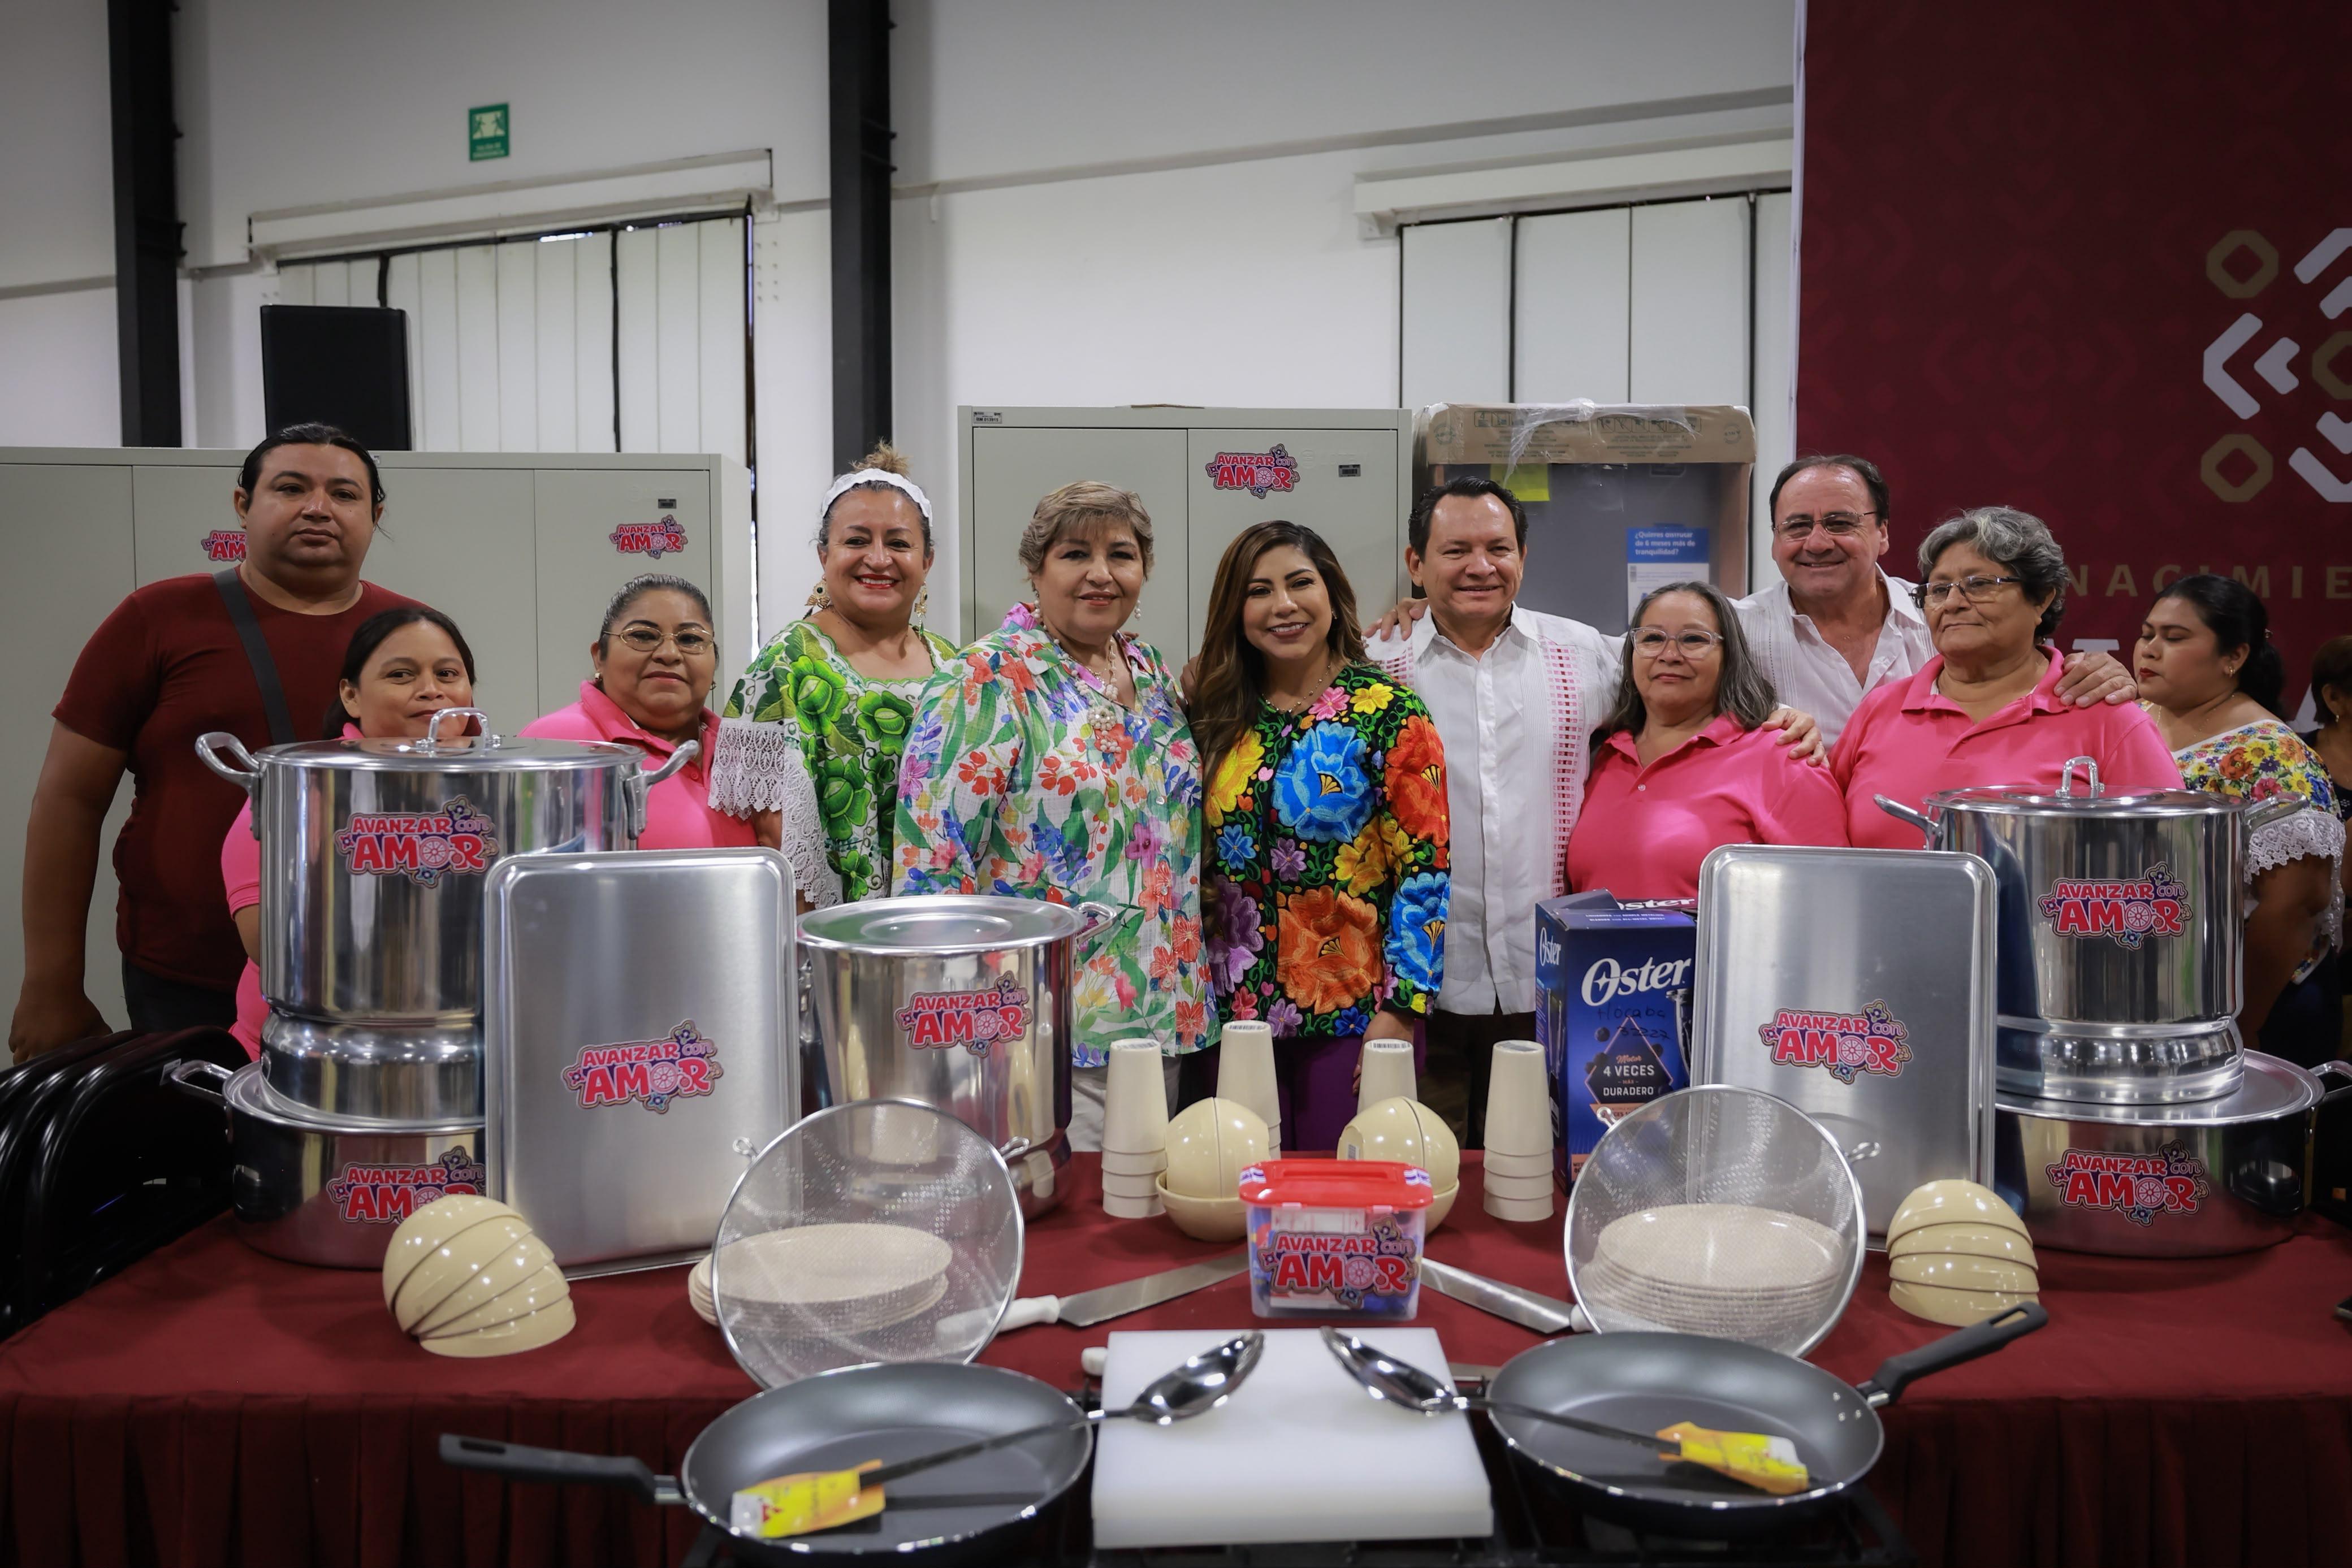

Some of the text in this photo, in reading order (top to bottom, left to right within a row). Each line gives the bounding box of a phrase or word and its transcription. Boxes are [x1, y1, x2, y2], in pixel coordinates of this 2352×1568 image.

[1217, 454, 1274, 466] AVANZAR
[1276, 457, 1295, 466] con
[1217, 466, 1292, 489] AMOR
[619, 525, 666, 534] AVANZAR
[619, 533, 682, 552] AMOR
[352, 817, 488, 834] AVANZAR con
[353, 833, 485, 870] AMOR
[2056, 883, 2184, 900] AVANZAR con
[1617, 898, 1694, 911] ster
[2057, 899, 2182, 933] AMOR
[1540, 927, 1561, 966] Oster
[1581, 957, 1691, 1006] Oster
[914, 991, 1001, 1011] AVANZAR
[913, 1004, 1023, 1045] AMOR
[1776, 1012, 1902, 1036] AVANZAR con
[581, 1042, 713, 1067] AVANZAR con
[1775, 1029, 1899, 1072] AMOR
[583, 1056, 711, 1104] AMOR
[1603, 1065, 1655, 1076] 4 VECES
[1603, 1086, 1654, 1096] DURADERO
[2065, 1153, 2200, 1175] AVANZAR con
[346, 1167, 484, 1185] AVANZAR con
[345, 1183, 479, 1219] AMO
[2065, 1171, 2197, 1212] AMOR
[1276, 1235, 1377, 1254] AVANZAR
[1276, 1254, 1410, 1292] AMOR
